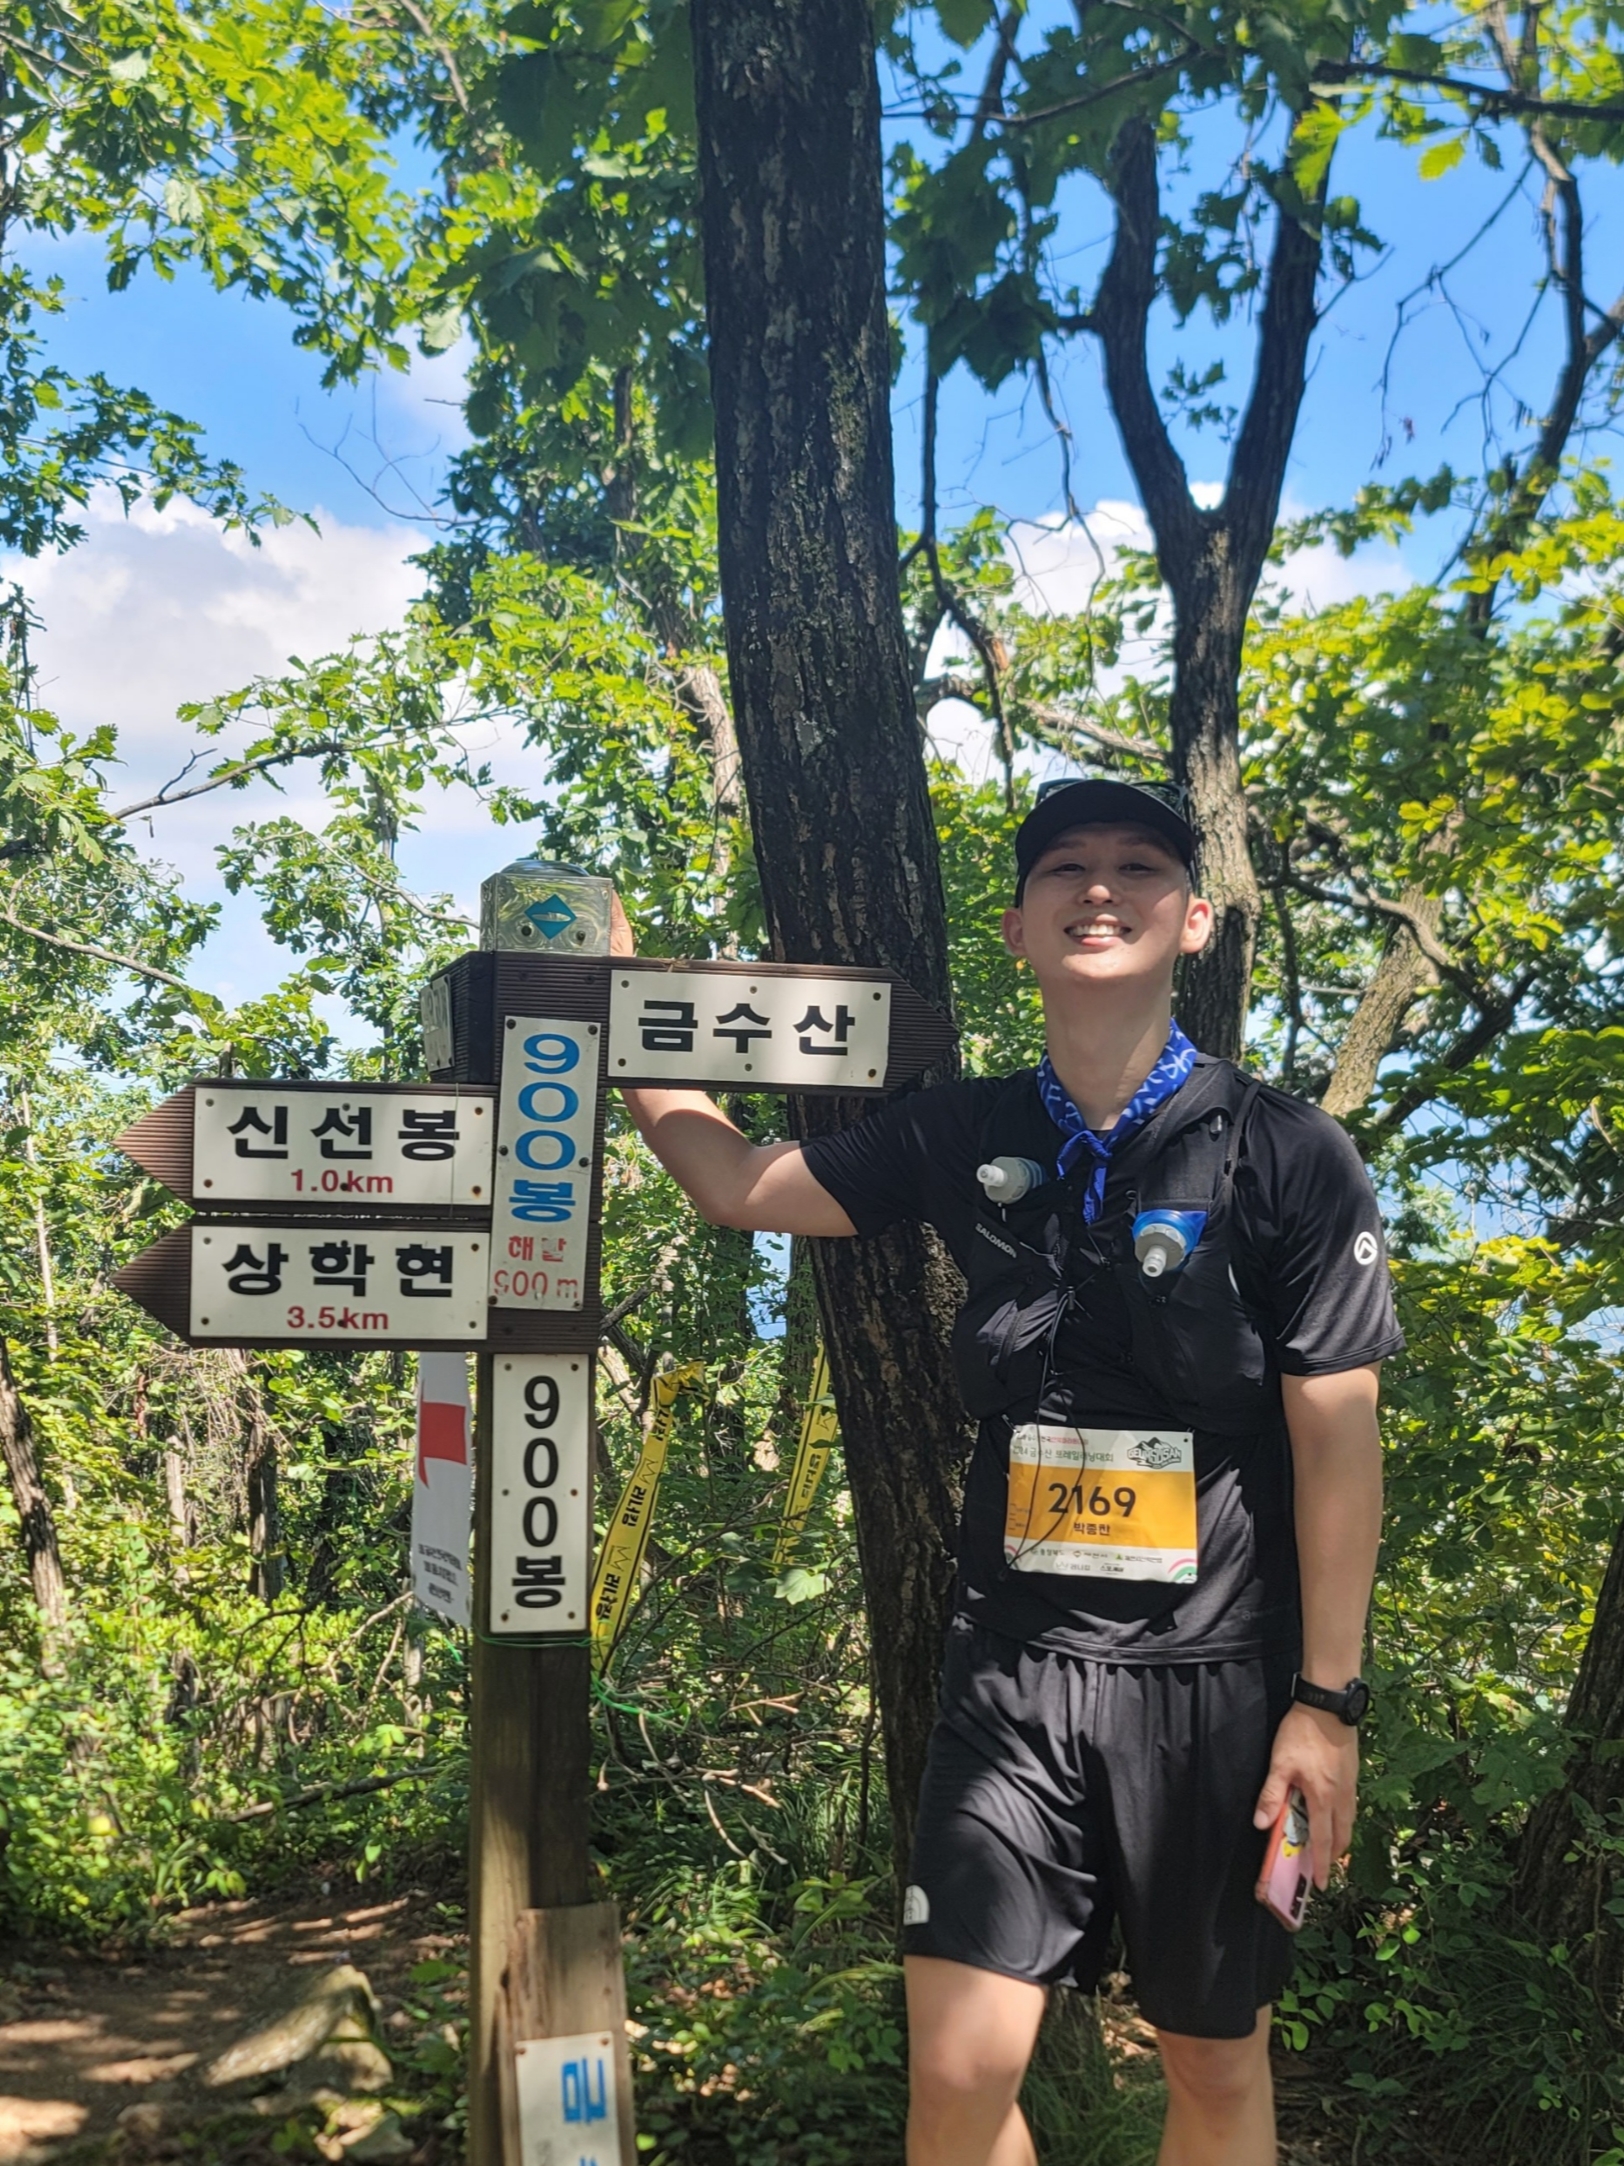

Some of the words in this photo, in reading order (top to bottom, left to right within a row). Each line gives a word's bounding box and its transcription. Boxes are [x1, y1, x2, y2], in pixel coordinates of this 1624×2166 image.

[638, 999, 856, 1056] 금수산
[227, 1105, 461, 1161] 신선봉
[508, 1033, 580, 1223] 900봉
[290, 1169, 394, 1195] 1.0km
[975, 1222, 1017, 1259] SALOMON
[222, 1242, 454, 1298] 상학현
[286, 1305, 389, 1331] 3.5km
[511, 1375, 566, 1609] 900봉
[621, 1484, 647, 1528] 러너킹
[1048, 1483, 1136, 1517] 2169
